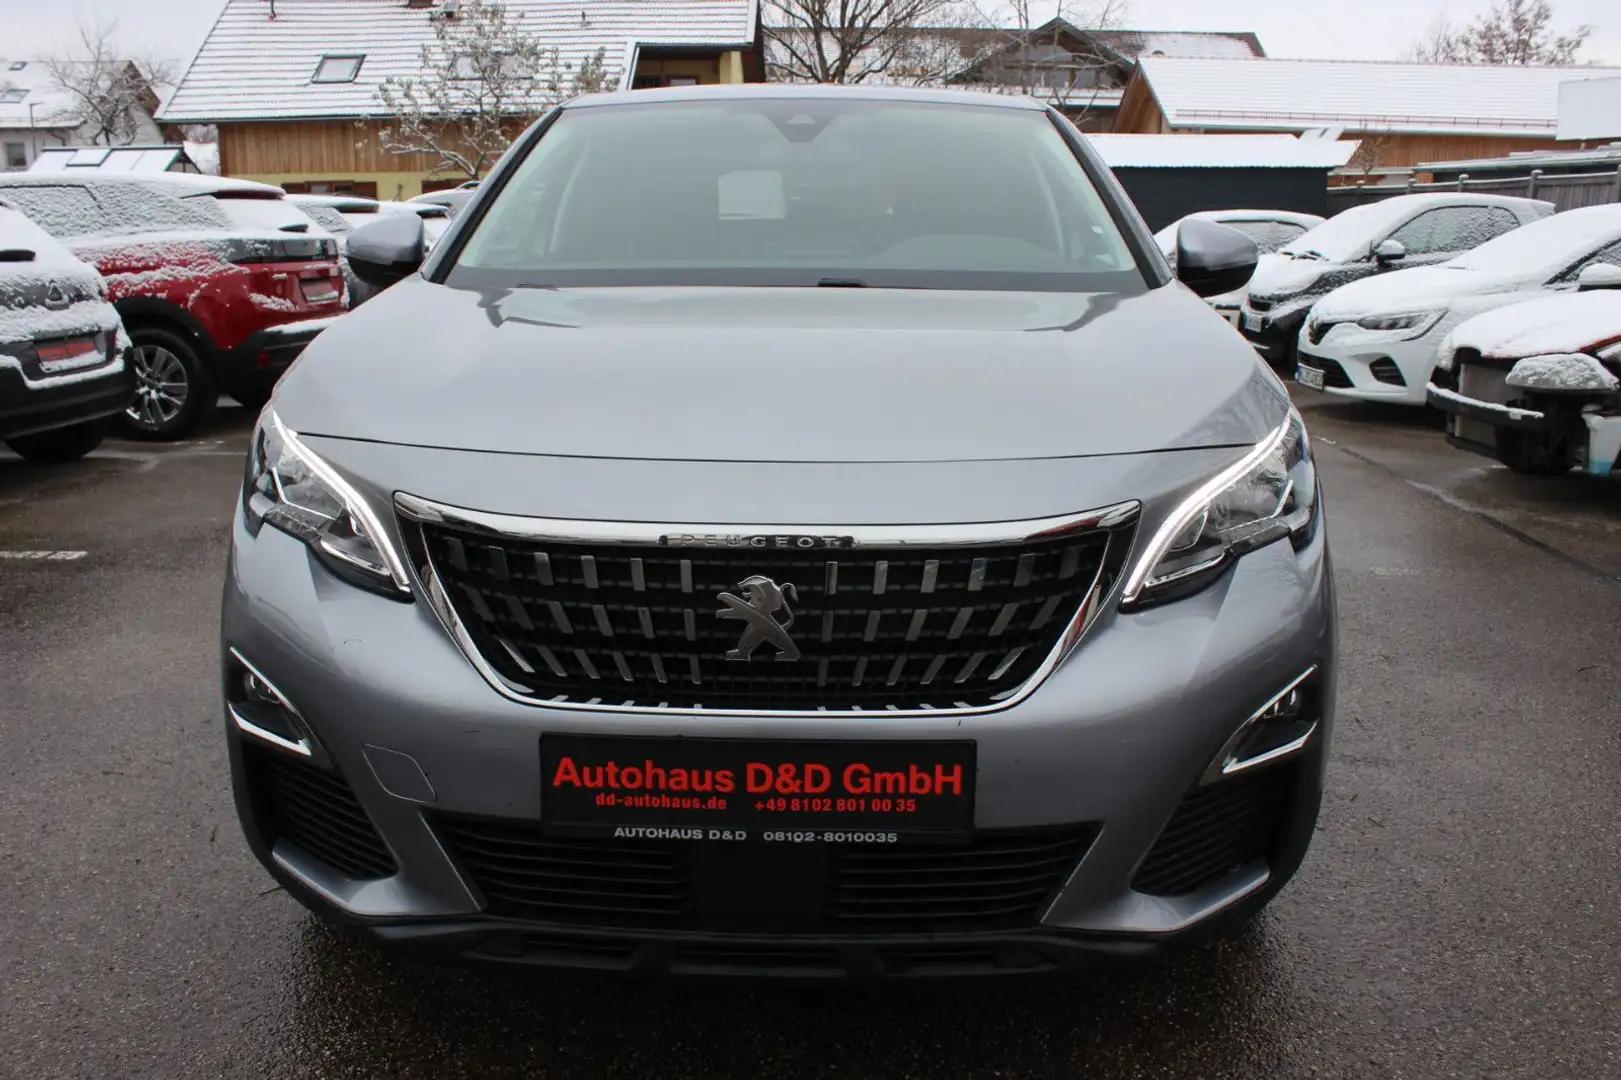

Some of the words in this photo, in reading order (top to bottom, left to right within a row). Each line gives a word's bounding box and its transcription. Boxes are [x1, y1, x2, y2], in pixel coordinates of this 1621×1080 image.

[680, 534, 837, 548] PEUGEOT
[552, 757, 736, 794] Autohaus
[746, 762, 832, 795] D&D
[842, 763, 963, 796] GmbH
[595, 792, 728, 810] dd-autohaus.de
[754, 798, 786, 812] +49
[791, 798, 832, 812] 8102
[836, 798, 866, 812] 801
[871, 799, 892, 812] 00
[896, 799, 917, 813] 35
[613, 827, 704, 840] AUTOHAUS
[708, 829, 747, 841] D&D
[763, 831, 898, 843] 08102-8010035
